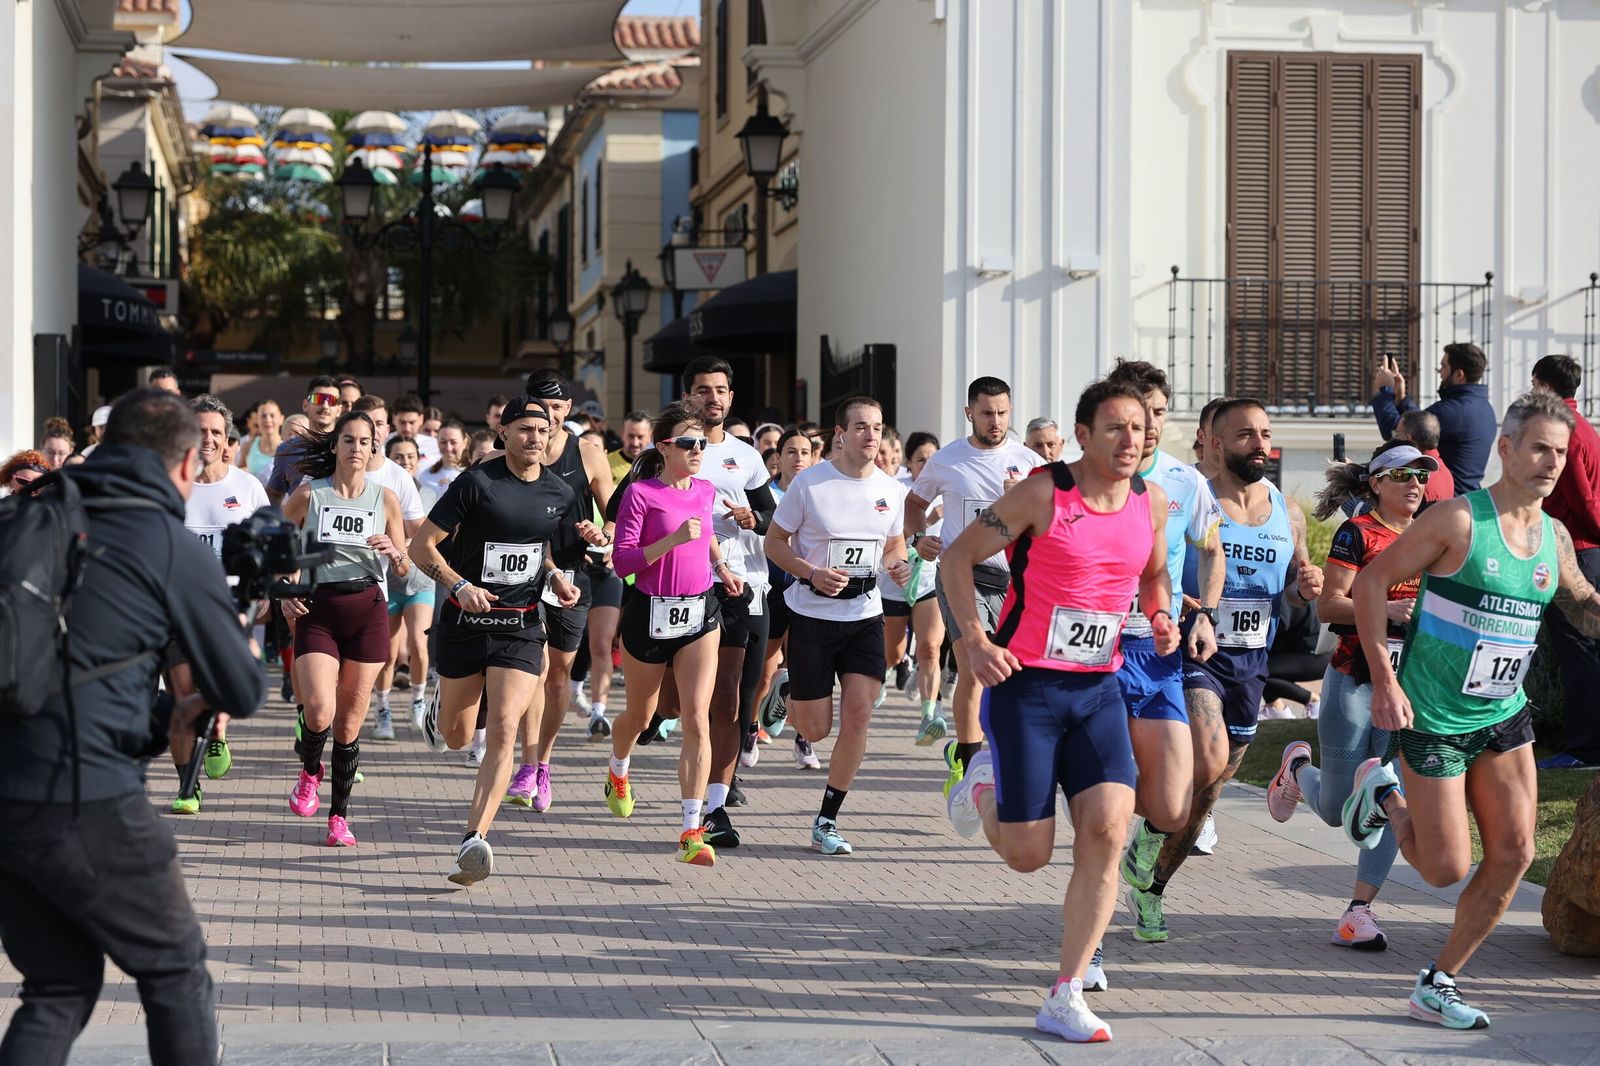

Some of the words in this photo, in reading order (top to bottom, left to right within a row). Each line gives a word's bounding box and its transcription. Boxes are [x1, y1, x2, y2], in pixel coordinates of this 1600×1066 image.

[332, 515, 364, 533] 408
[845, 548, 863, 564] 27
[1222, 542, 1276, 563] ERESO
[499, 554, 528, 572] 108
[1478, 594, 1541, 618] ATLETISMO
[463, 615, 519, 625] WONG
[669, 607, 689, 625] 84
[1231, 610, 1260, 632] 169
[1068, 622, 1107, 649] 240
[1491, 656, 1522, 681] 179
